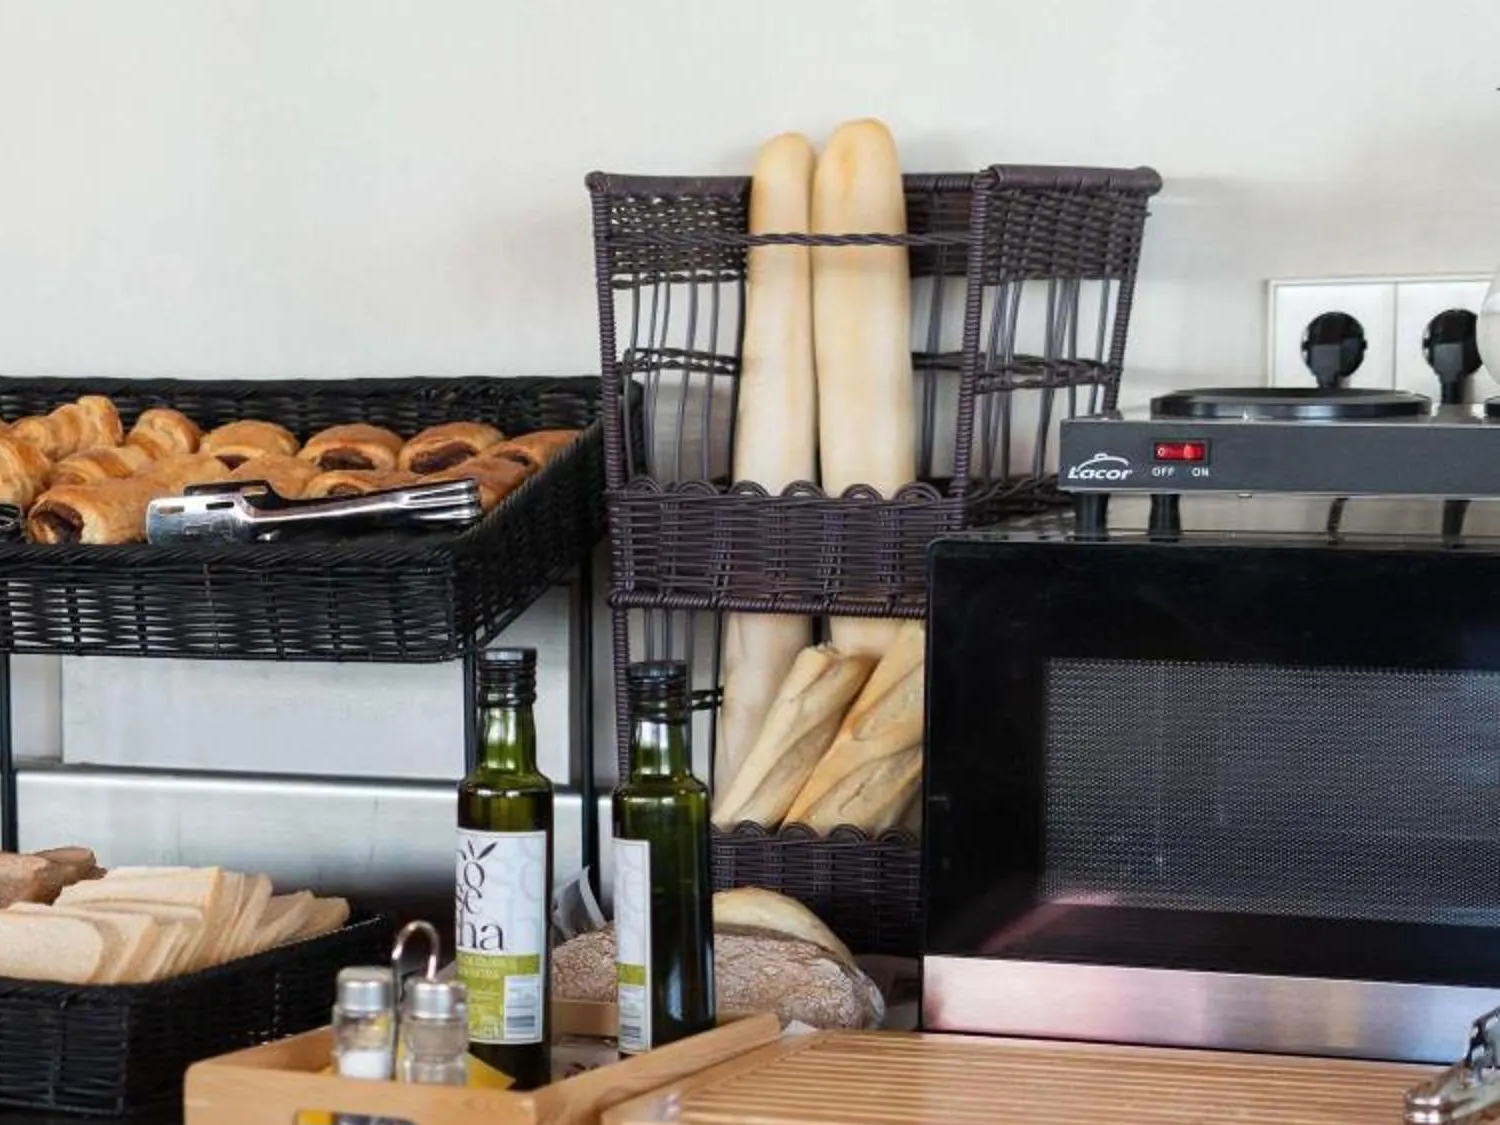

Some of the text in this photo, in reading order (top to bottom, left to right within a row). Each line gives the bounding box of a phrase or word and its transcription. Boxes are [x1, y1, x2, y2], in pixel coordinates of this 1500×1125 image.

[1067, 465, 1133, 481] Lacor
[1152, 467, 1209, 477] OFF ON
